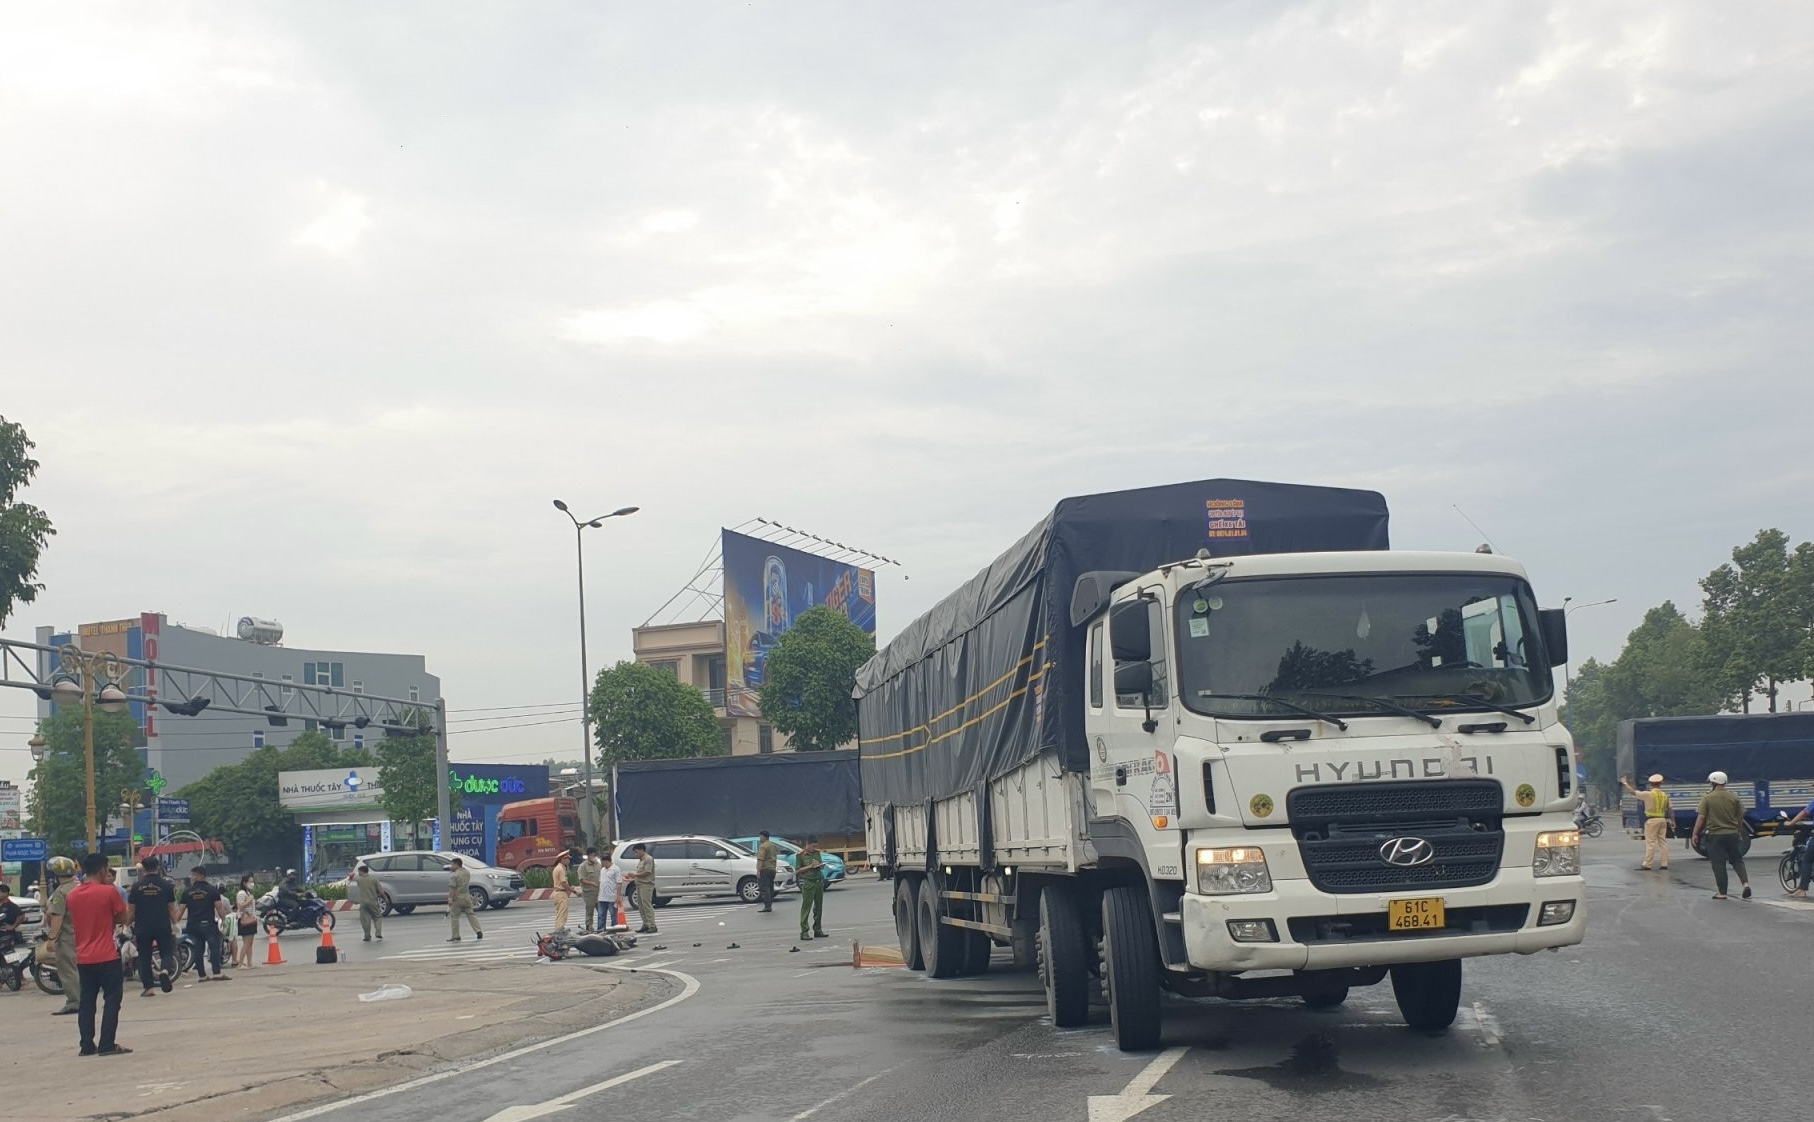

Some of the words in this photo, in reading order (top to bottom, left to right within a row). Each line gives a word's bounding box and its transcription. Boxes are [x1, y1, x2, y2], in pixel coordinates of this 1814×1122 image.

[282, 783, 299, 794] NHÀ
[301, 781, 326, 793] THUỐC
[327, 783, 342, 791] TÂY
[456, 808, 472, 820] NHÀ
[450, 821, 470, 832] HUỐC
[472, 821, 484, 832] TÂY
[471, 837, 483, 847] CỤ
[1405, 901, 1428, 914] 61C
[1395, 914, 1437, 928] 468.41
